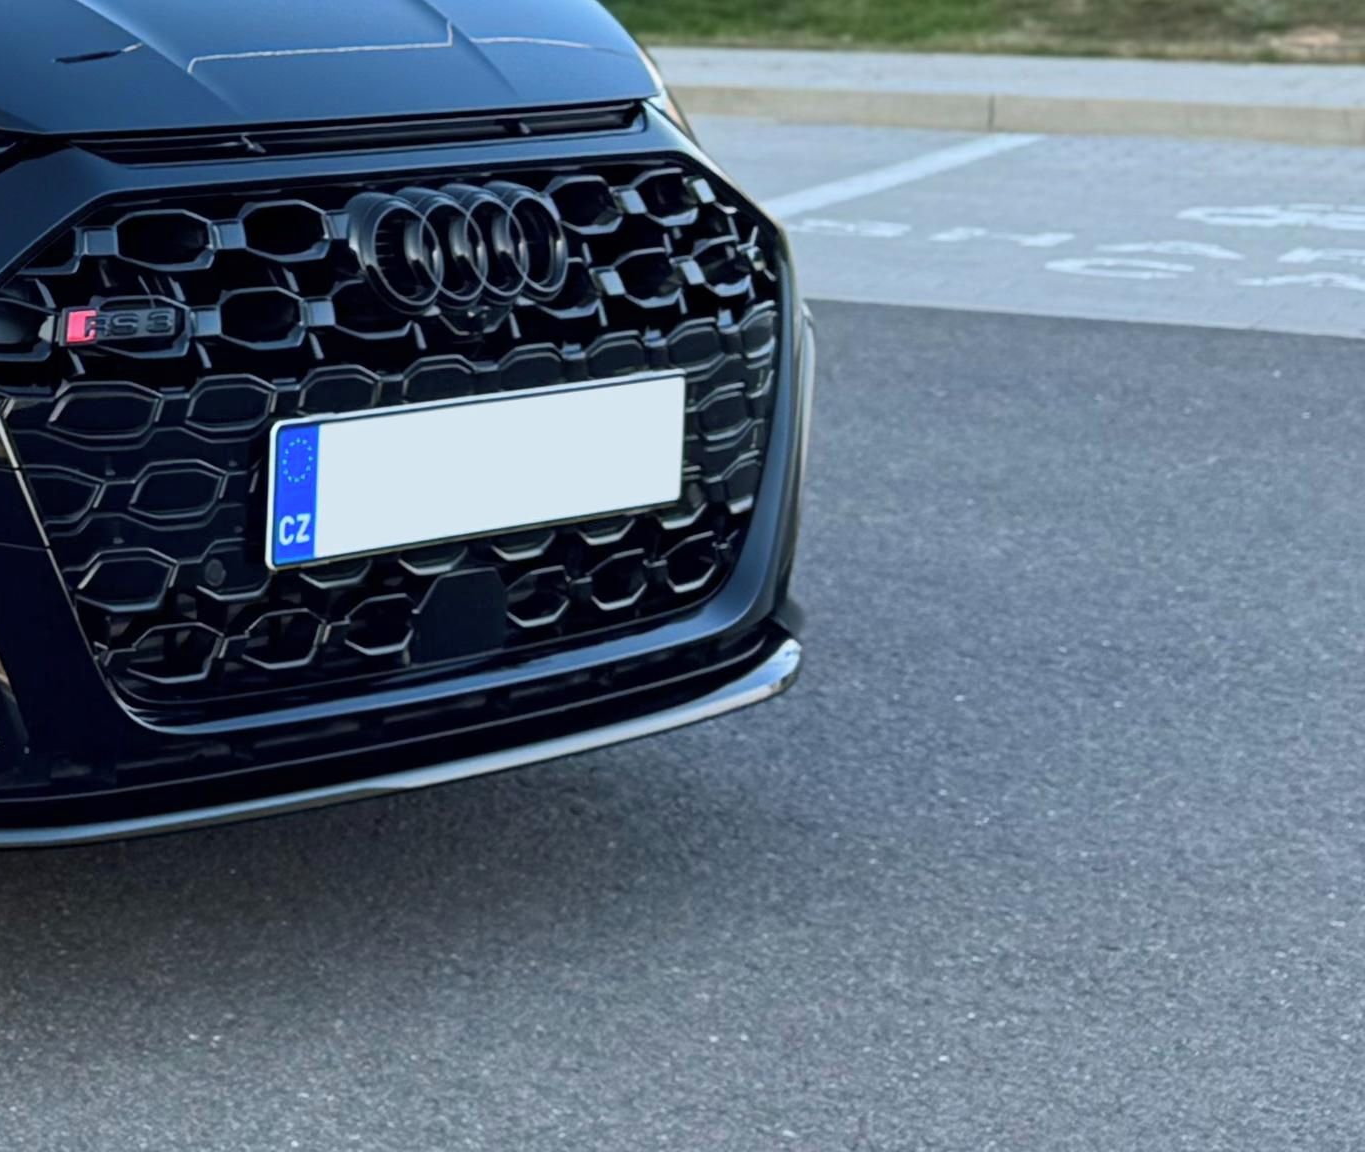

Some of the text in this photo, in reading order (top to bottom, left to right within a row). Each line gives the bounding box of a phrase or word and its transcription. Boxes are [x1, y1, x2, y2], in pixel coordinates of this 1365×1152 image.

[84, 310, 172, 337] RS 3
[279, 512, 311, 547] CZ
